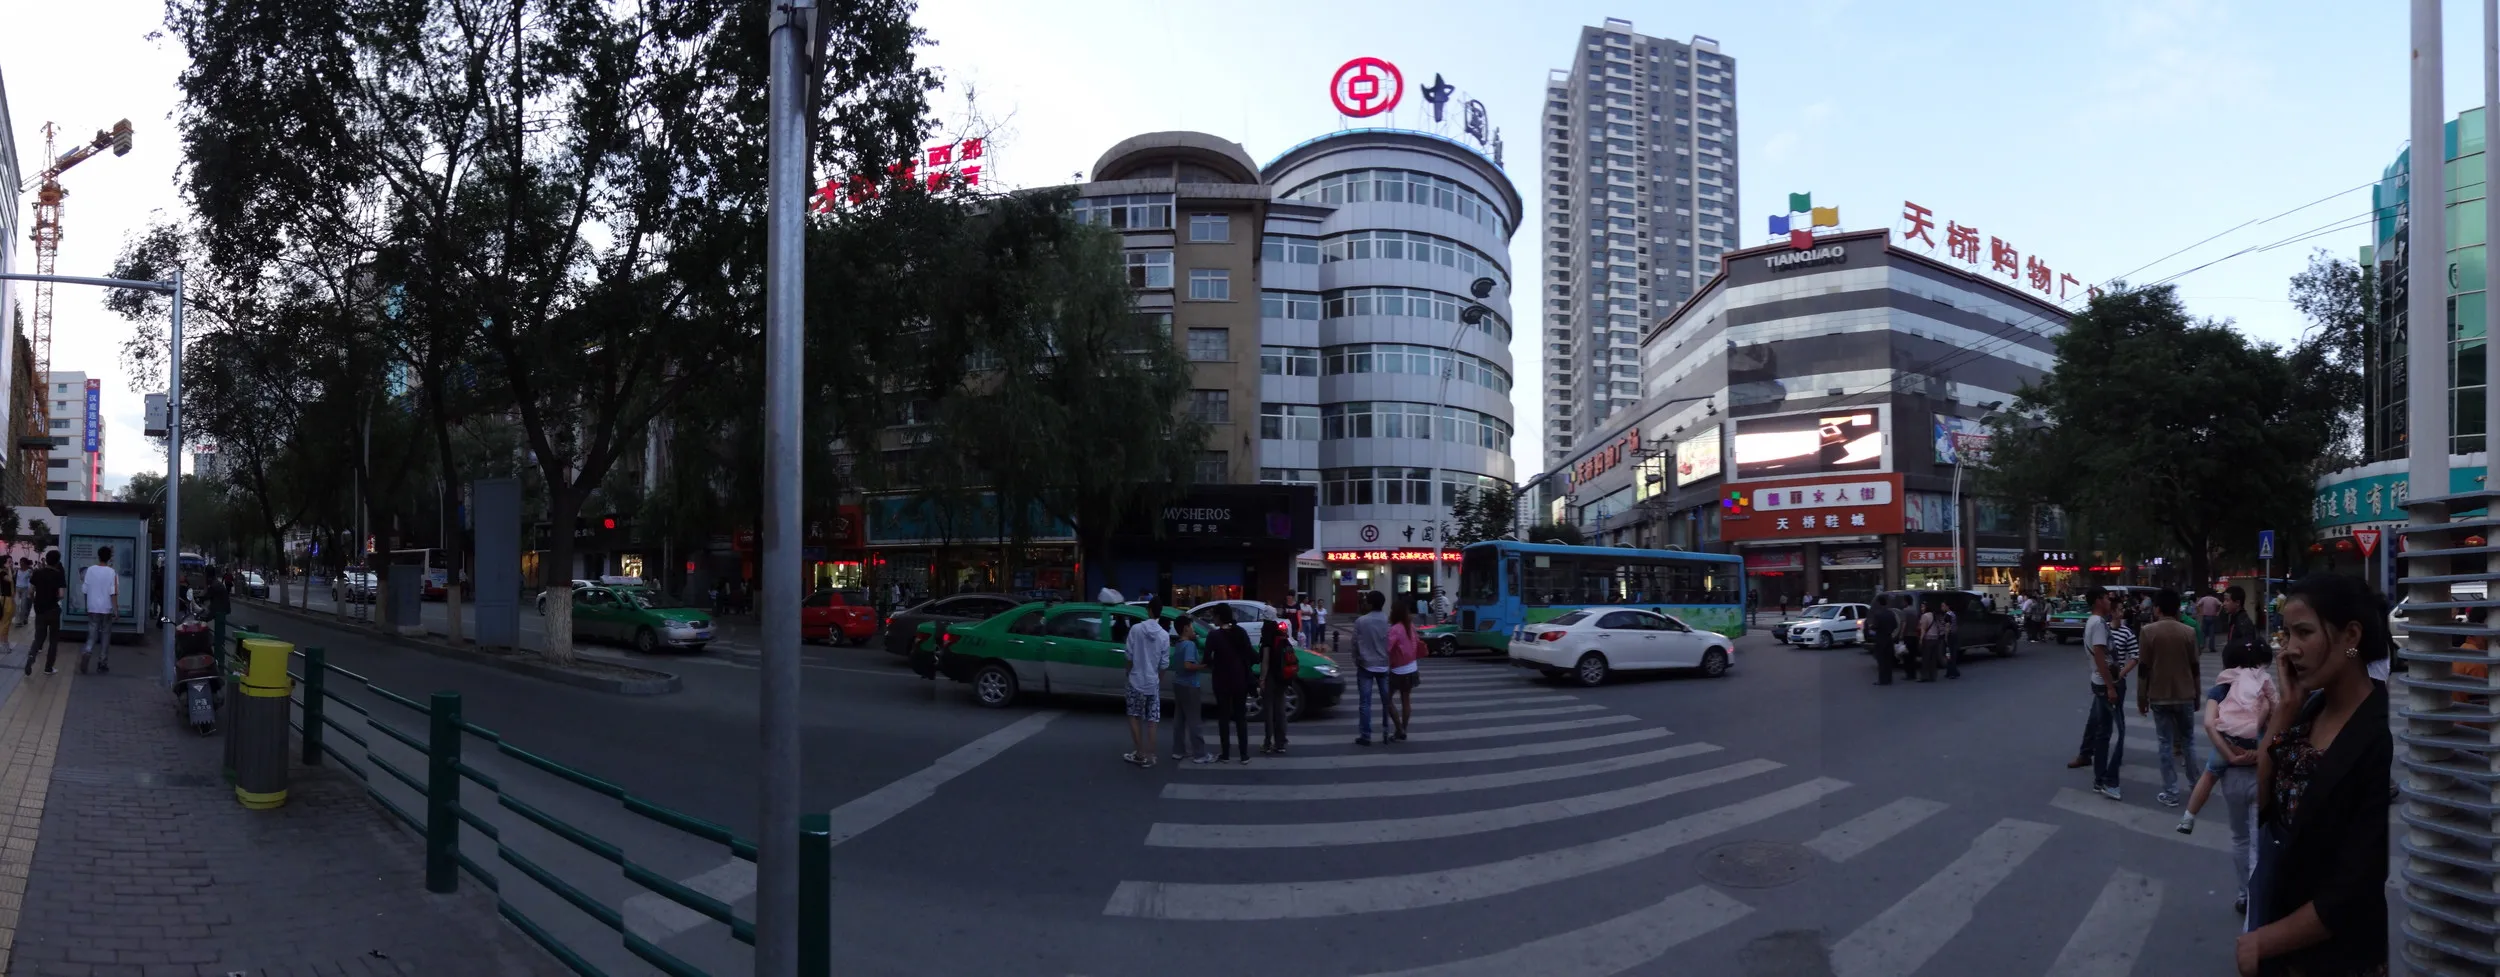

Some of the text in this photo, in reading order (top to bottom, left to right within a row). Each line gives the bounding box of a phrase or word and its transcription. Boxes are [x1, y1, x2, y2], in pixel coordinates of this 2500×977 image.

[926, 137, 983, 168] 西部
[1764, 245, 1845, 268] TIANQIAO
[1161, 506, 1232, 521] MYSHEROS
[1777, 513, 1866, 531] 天桥鞋城
